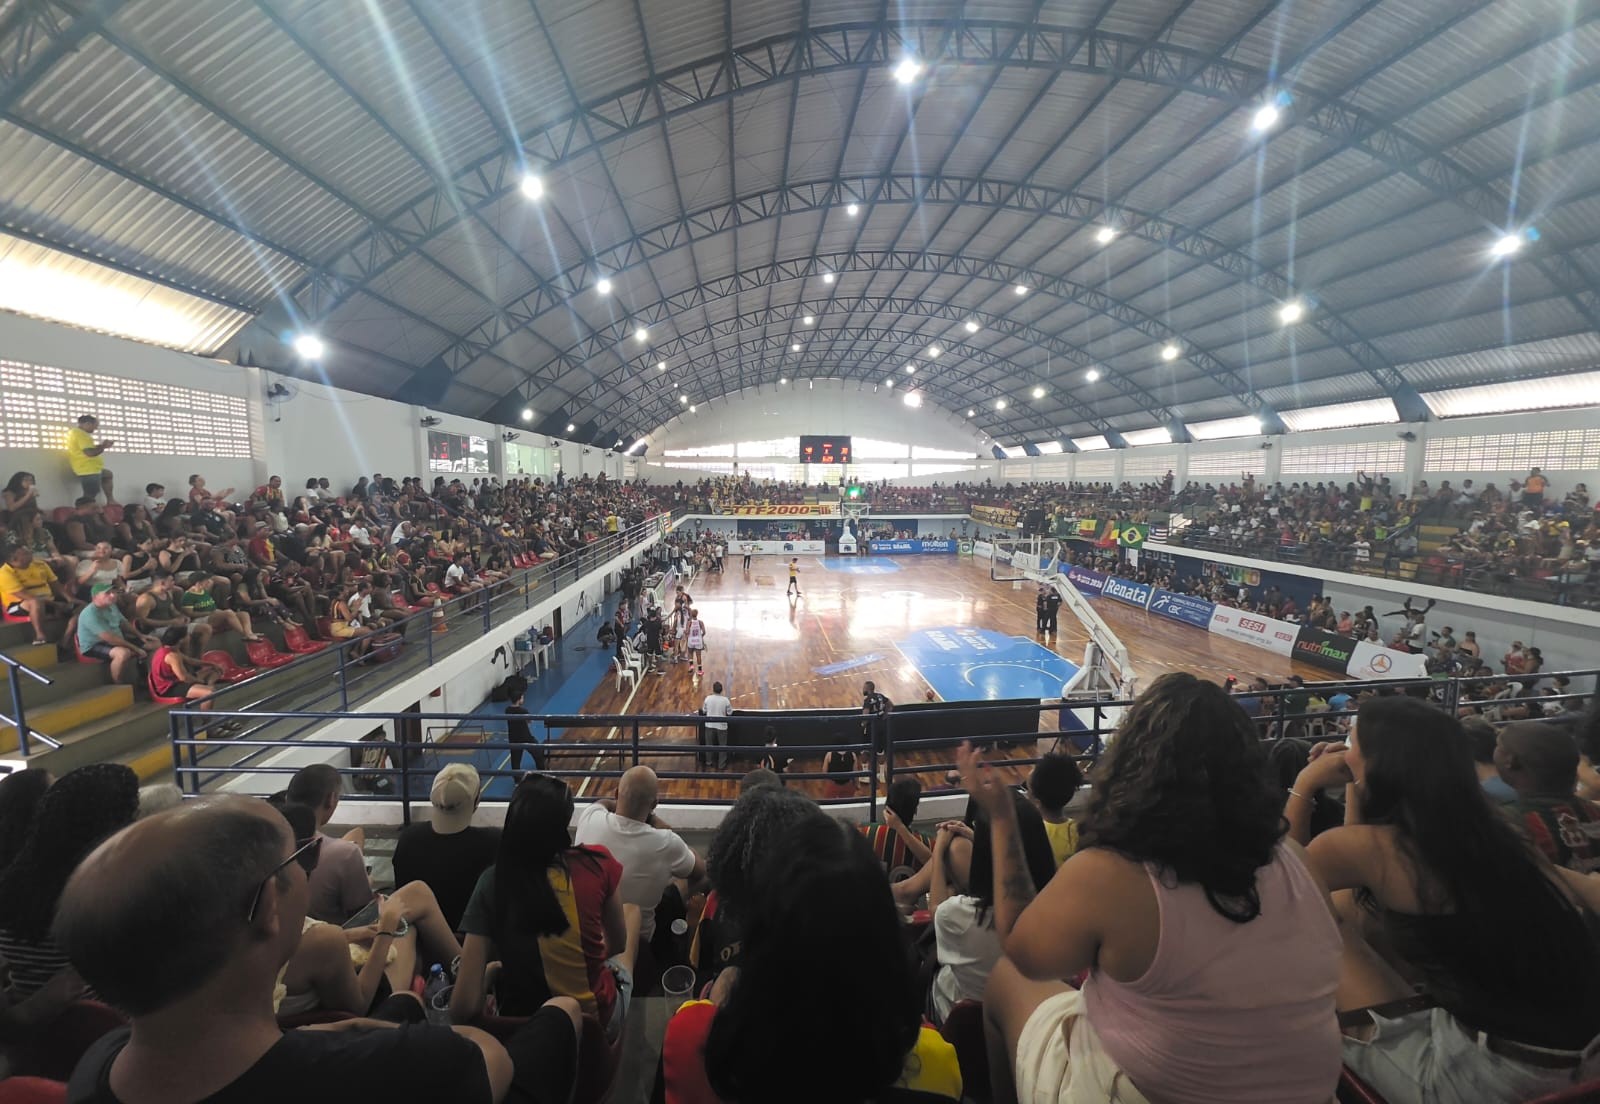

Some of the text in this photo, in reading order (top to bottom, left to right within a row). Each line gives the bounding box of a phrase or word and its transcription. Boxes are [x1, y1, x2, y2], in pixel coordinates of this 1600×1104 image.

[1105, 579, 1147, 604] Renata
[1240, 619, 1264, 632] SESI
[1296, 640, 1349, 661] nutrimax
